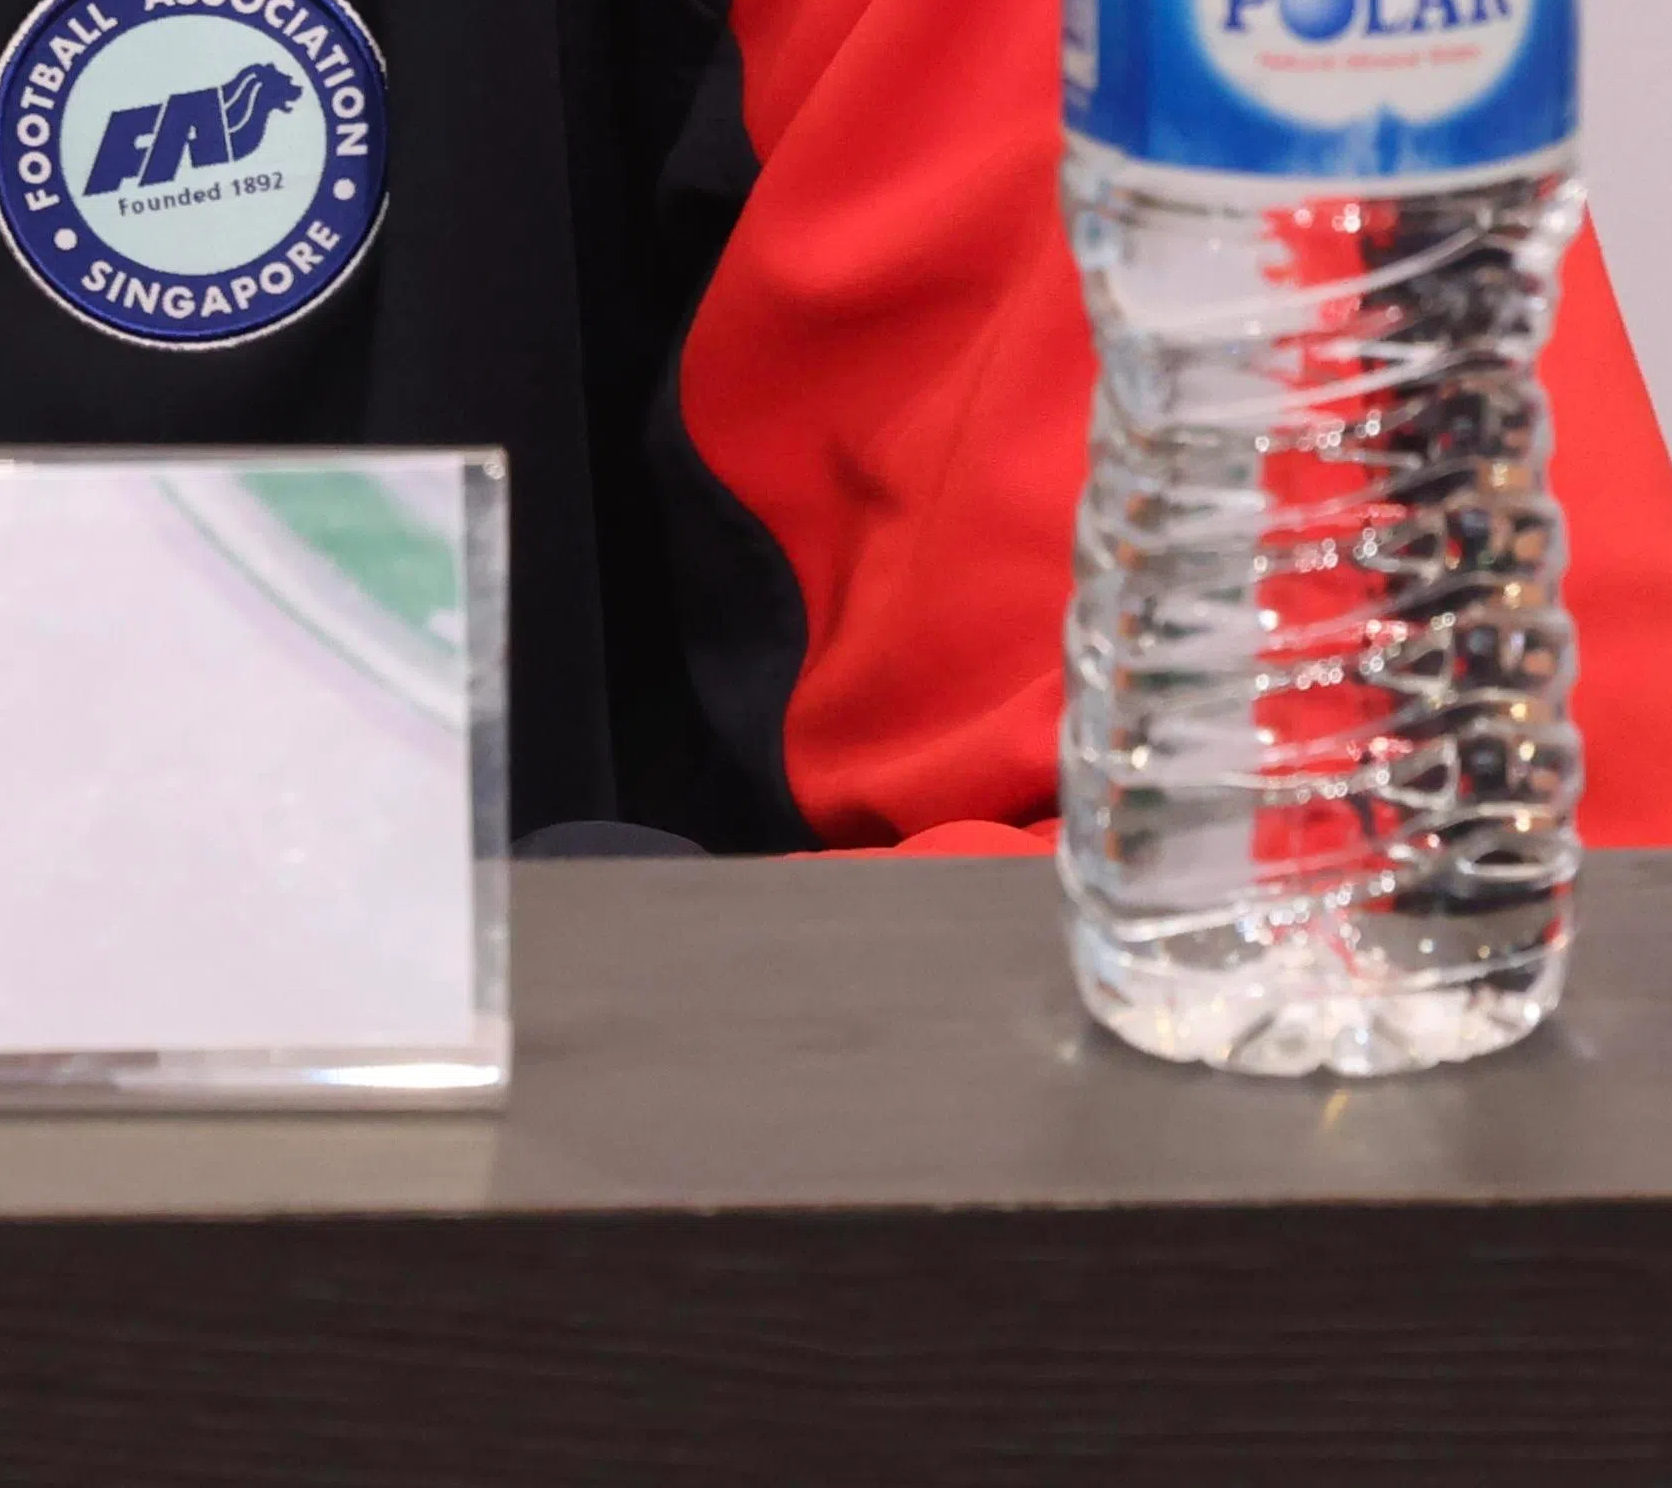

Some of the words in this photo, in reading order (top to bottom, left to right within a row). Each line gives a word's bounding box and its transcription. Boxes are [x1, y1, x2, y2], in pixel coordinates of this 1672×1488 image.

[16, 2, 119, 213] FOOTBALL
[117, 184, 222, 217] Founded
[232, 171, 285, 198] 1892
[81, 220, 342, 319] SINGAPORE
